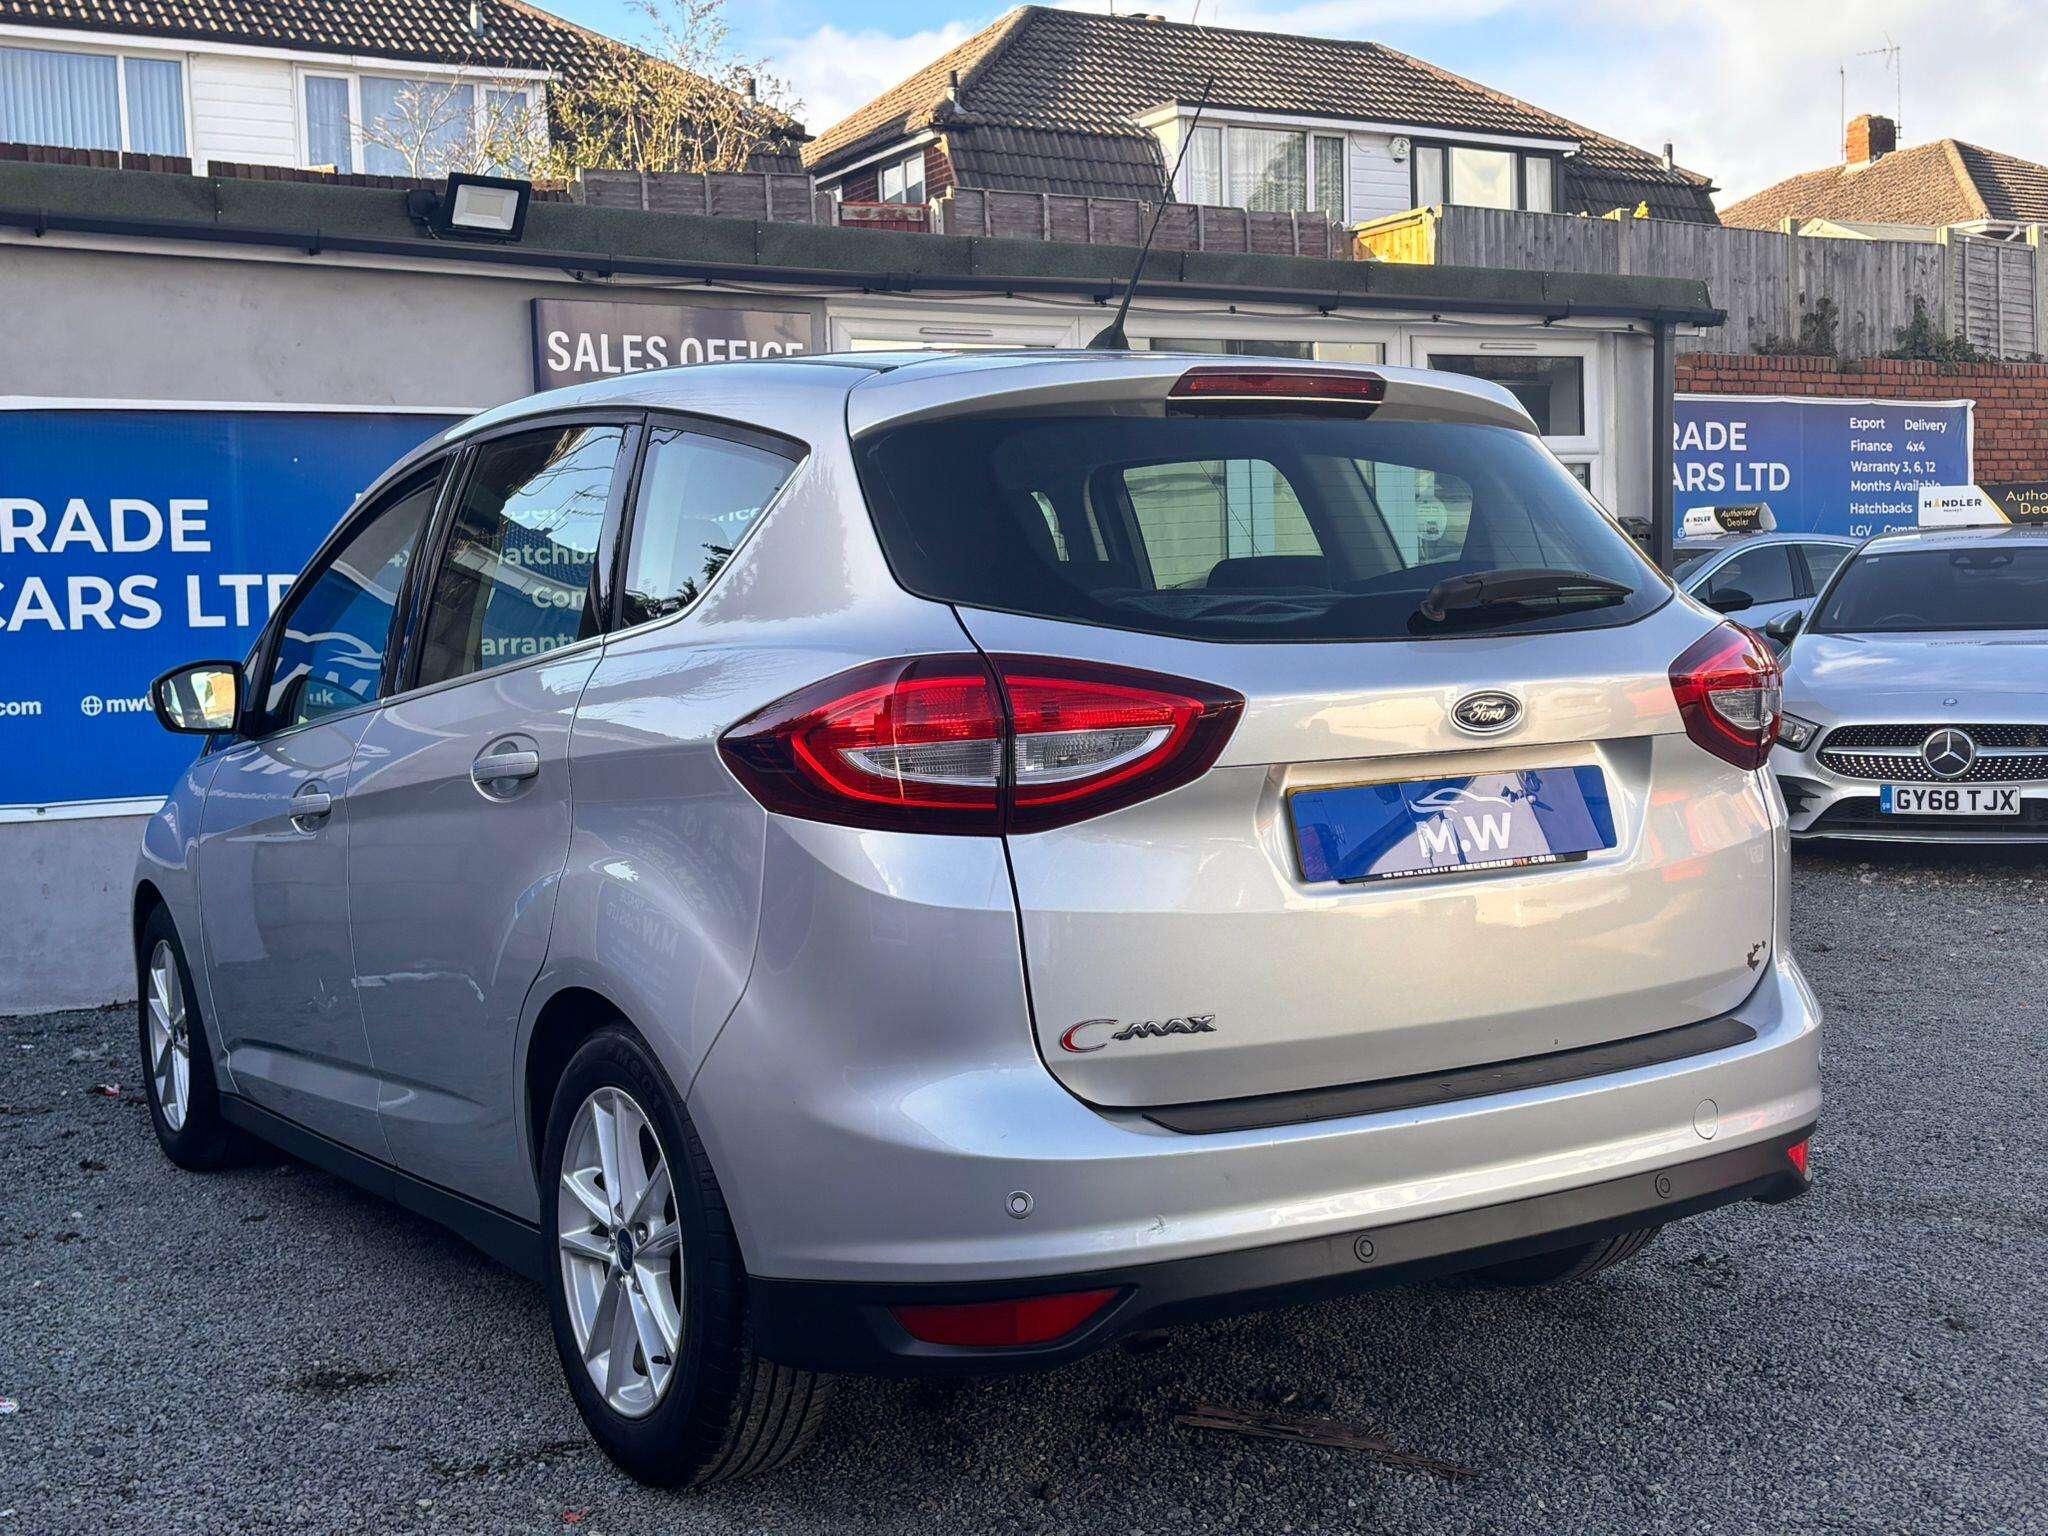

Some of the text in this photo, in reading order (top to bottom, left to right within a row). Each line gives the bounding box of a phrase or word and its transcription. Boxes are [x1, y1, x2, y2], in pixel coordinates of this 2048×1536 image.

[547, 331, 668, 374] SALES
[1849, 417, 1886, 431] Export
[1904, 419, 1947, 433] Delivery
[1850, 439, 1893, 452] Finance
[1906, 440, 1926, 452] 4x4
[1850, 461, 1936, 475] Warranty 3, 6, 12
[1735, 462, 1790, 492] LTD
[1850, 480, 1891, 492] Months
[1721, 506, 1758, 518] Authorised
[1849, 502, 1913, 514] Hatchbacks
[1727, 518, 1749, 527] Dealer
[1849, 525, 1873, 537] LGV
[0, 574, 163, 632] ARS
[1469, 700, 1507, 722] Ford
[1897, 789, 2015, 811] GY68 TJX
[1414, 812, 1512, 858] M.W
